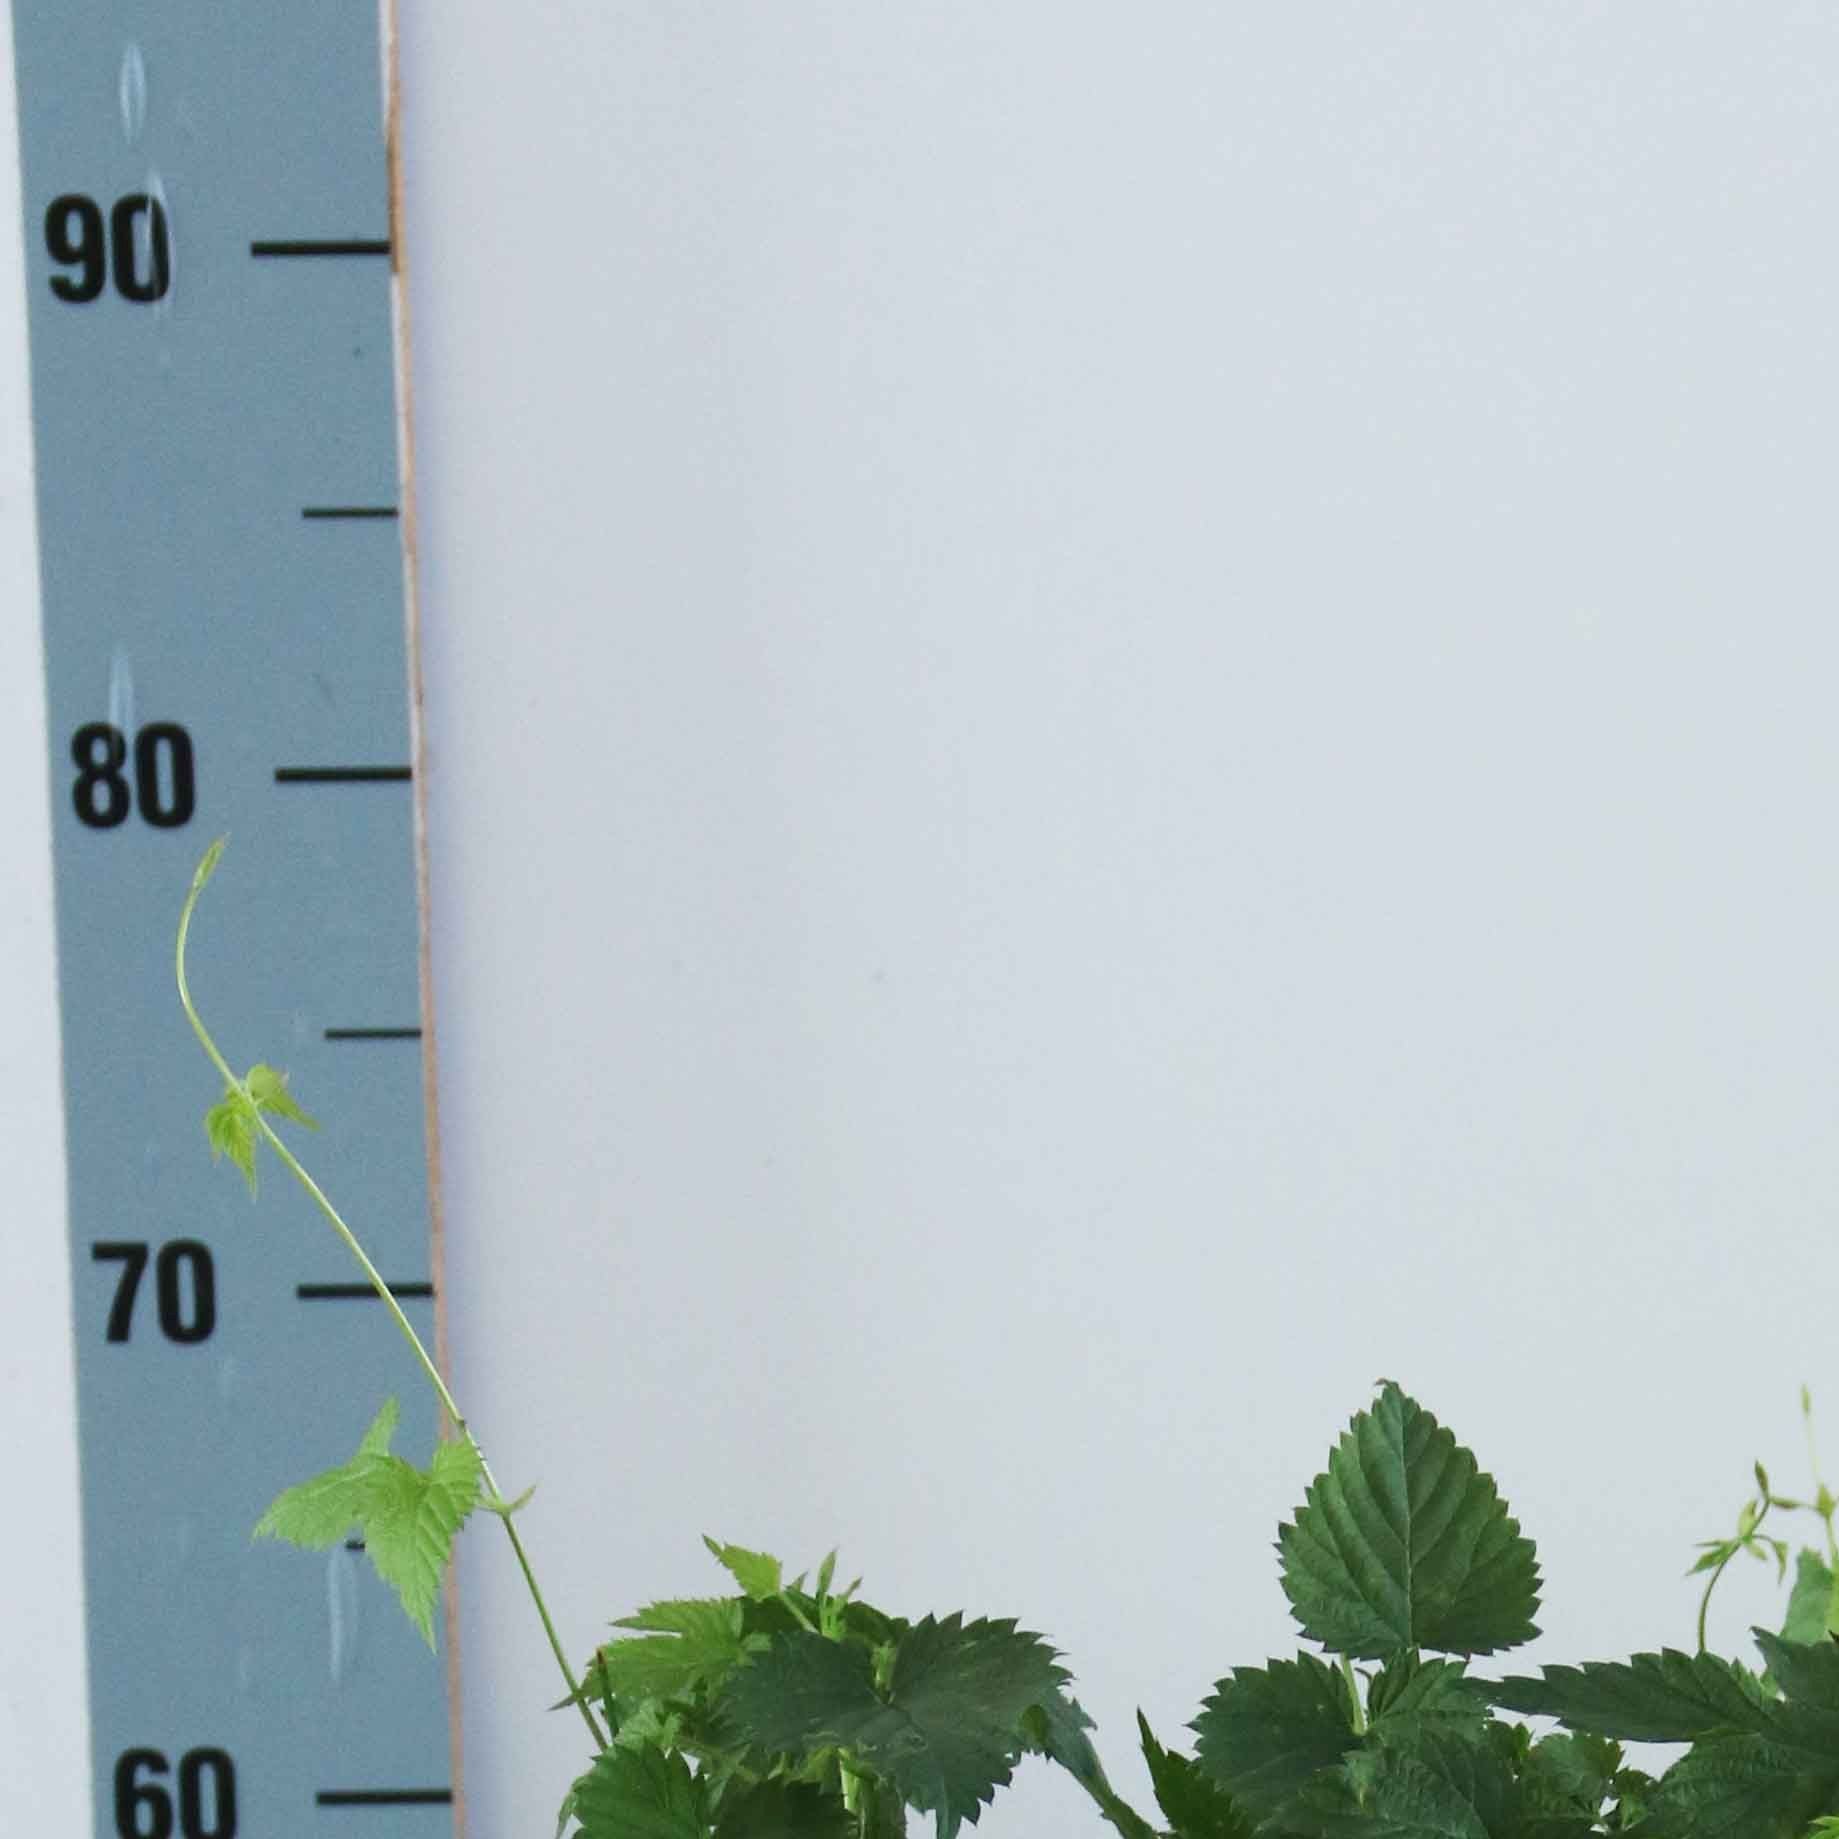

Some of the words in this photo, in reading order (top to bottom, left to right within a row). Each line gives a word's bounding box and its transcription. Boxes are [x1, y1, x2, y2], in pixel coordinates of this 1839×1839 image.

[43, 193, 171, 304] 90
[70, 721, 197, 831] 80
[90, 1238, 217, 1346] 70
